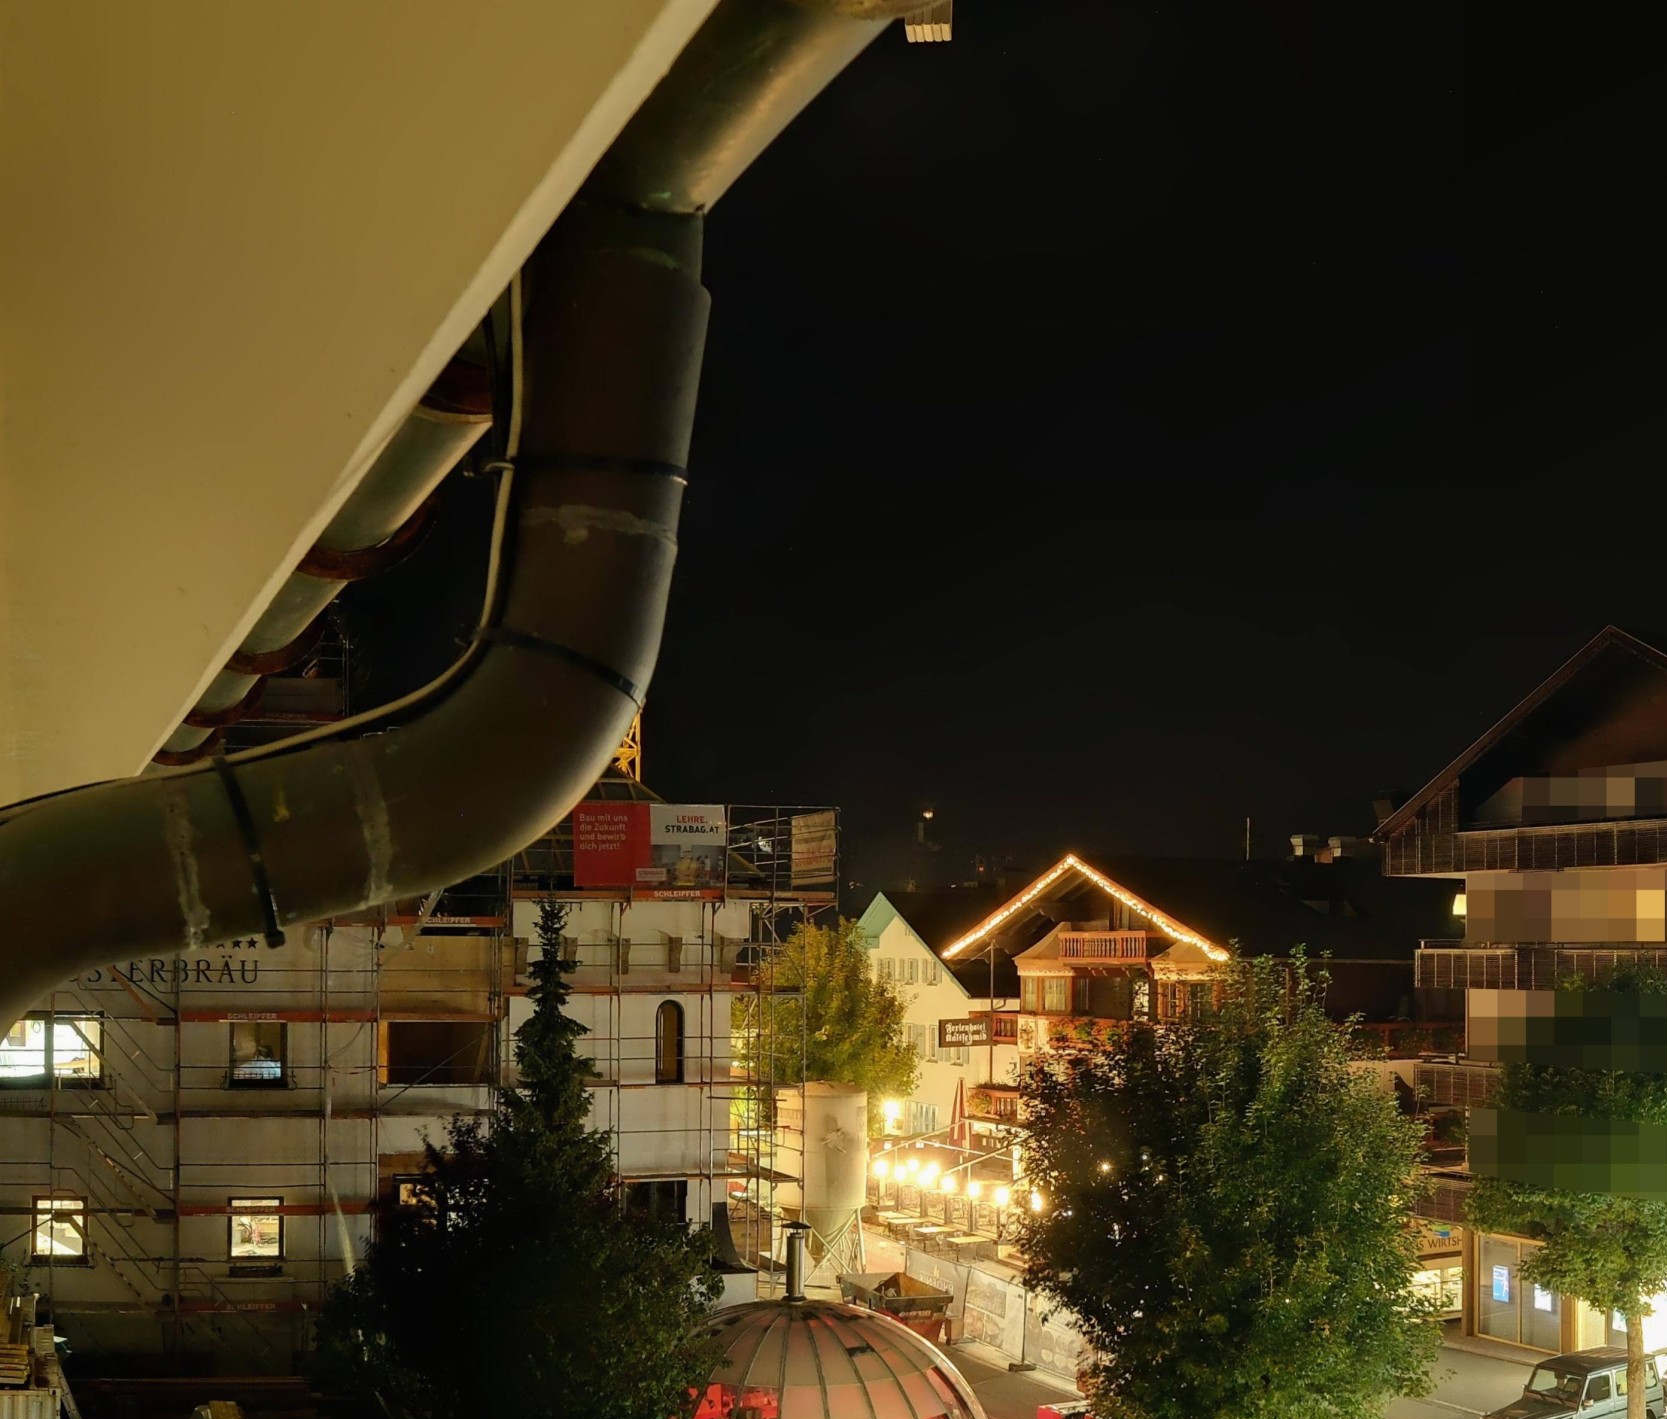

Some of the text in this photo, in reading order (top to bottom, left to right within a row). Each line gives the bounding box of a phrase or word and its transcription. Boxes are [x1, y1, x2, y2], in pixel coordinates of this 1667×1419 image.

[579, 814, 595, 822] Bau
[598, 813, 609, 822] mit
[677, 815, 707, 824] LEHRE.
[665, 825, 719, 834] STRABAG.AT
[599, 842, 620, 851] jetzt!
[227, 1012, 278, 1021] SCHLEIPFER
